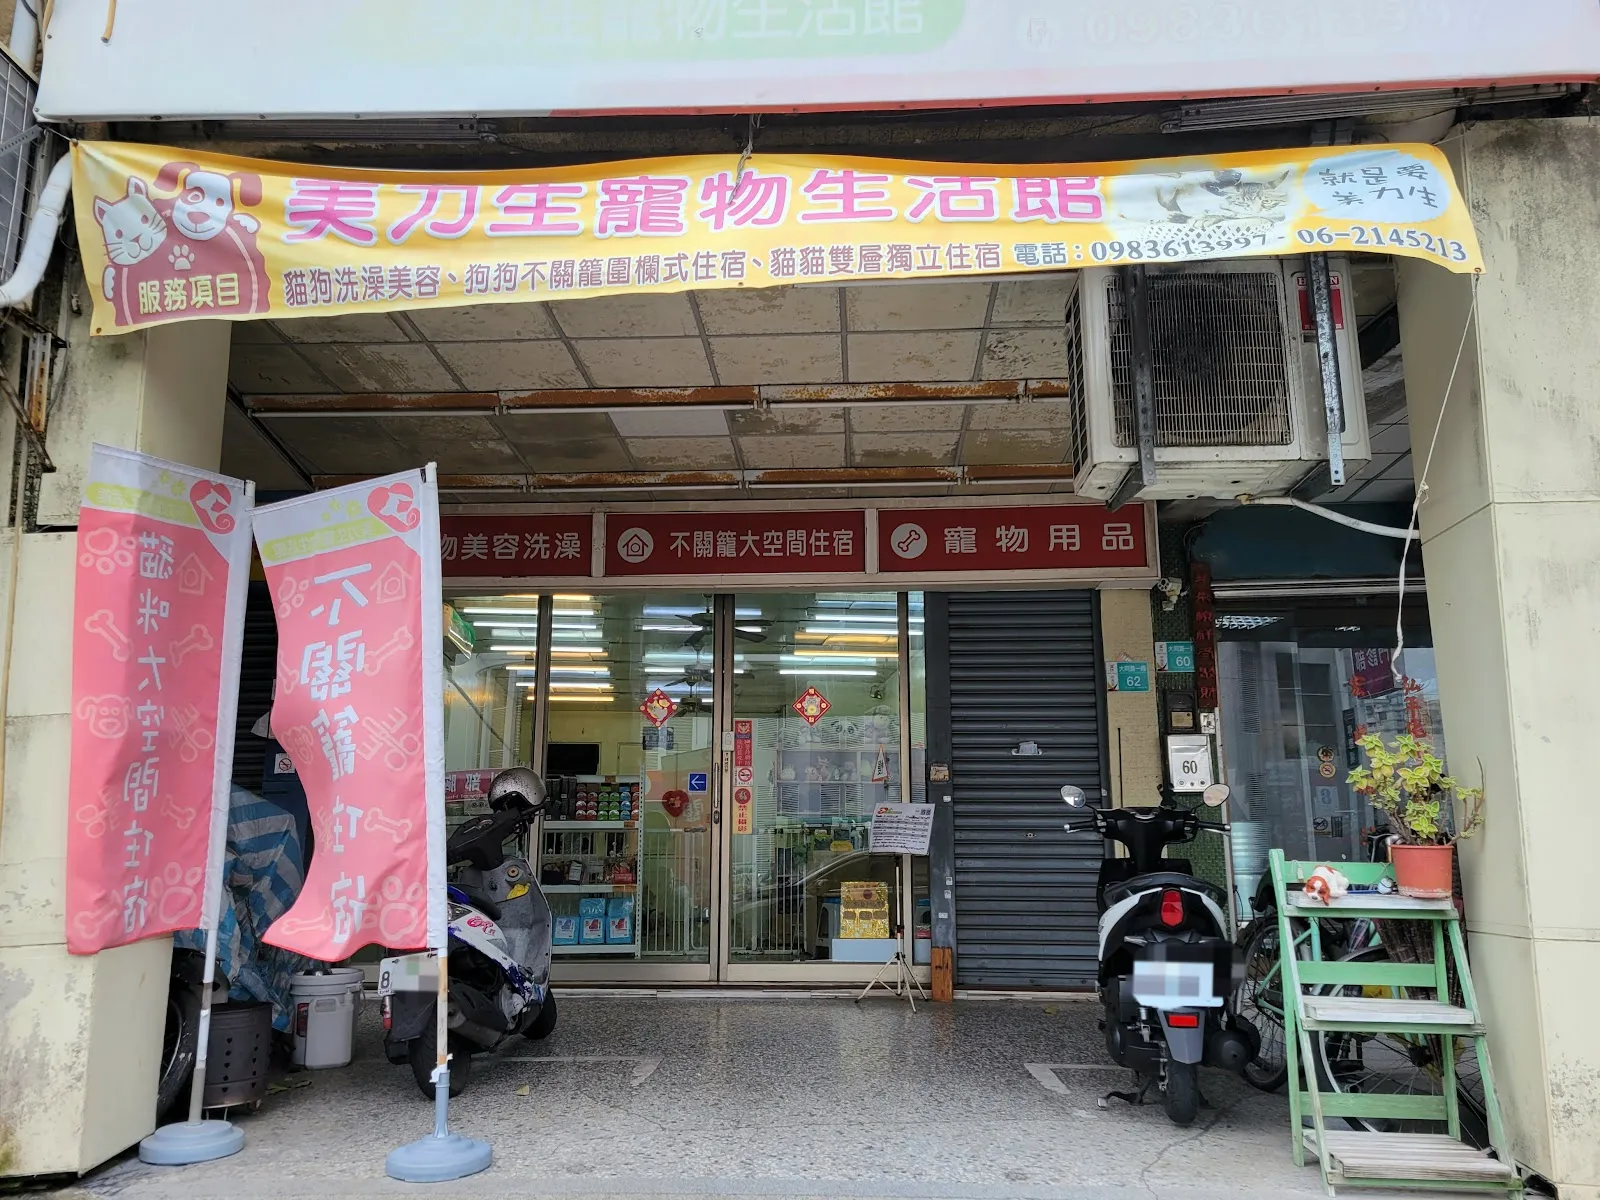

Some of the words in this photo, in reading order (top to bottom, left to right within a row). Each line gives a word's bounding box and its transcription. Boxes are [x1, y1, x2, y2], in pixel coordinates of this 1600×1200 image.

[284, 169, 1103, 244] 美力生寵物生活館
[1297, 226, 1468, 263] 06-2145213
[138, 272, 240, 314] 服務項目
[670, 528, 854, 558] 不關籠大空間住宿
[943, 522, 1135, 554] 寵物用品
[1175, 656, 1191, 667] 60
[1126, 675, 1142, 687] 62
[1182, 760, 1198, 774] 60
